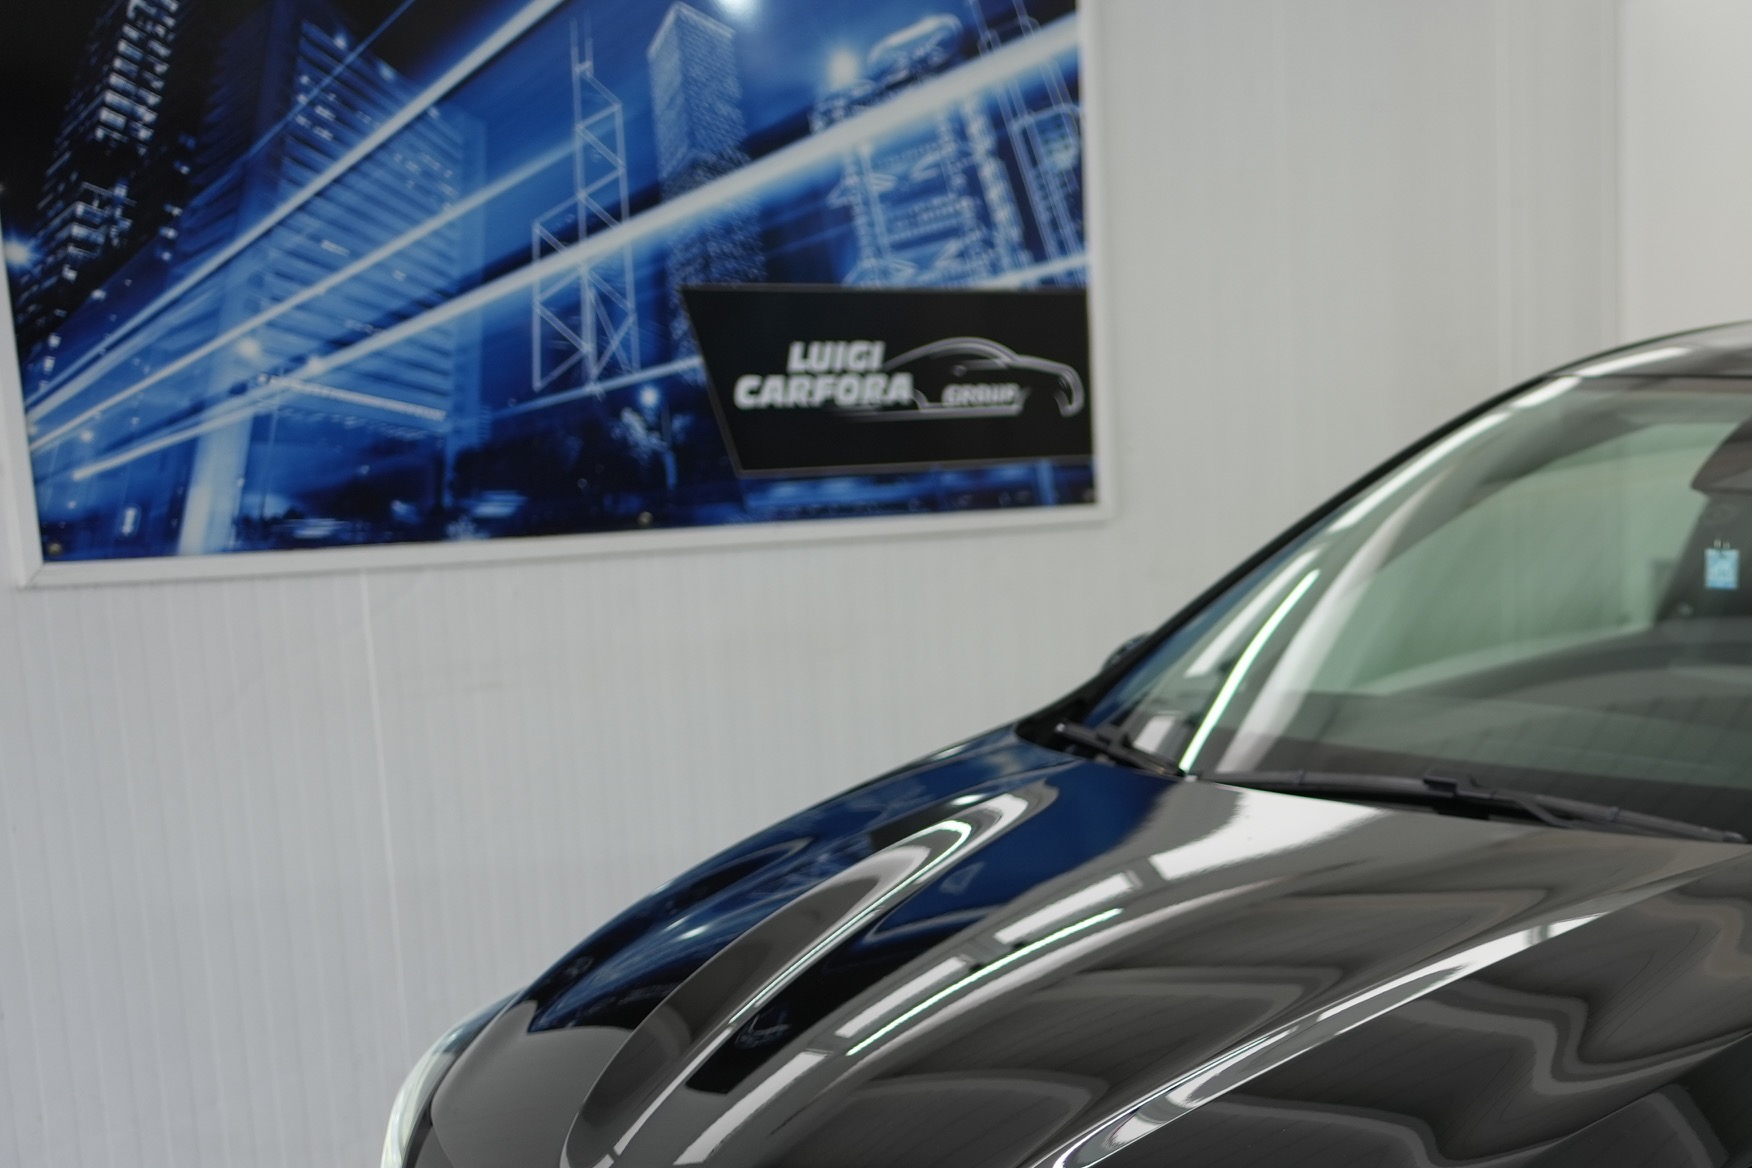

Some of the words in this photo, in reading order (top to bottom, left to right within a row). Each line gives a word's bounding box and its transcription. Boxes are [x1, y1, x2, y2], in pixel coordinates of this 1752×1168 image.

[787, 341, 885, 373] LUIGI
[733, 372, 915, 409] CARFORA
[941, 383, 1021, 408] GROUP
